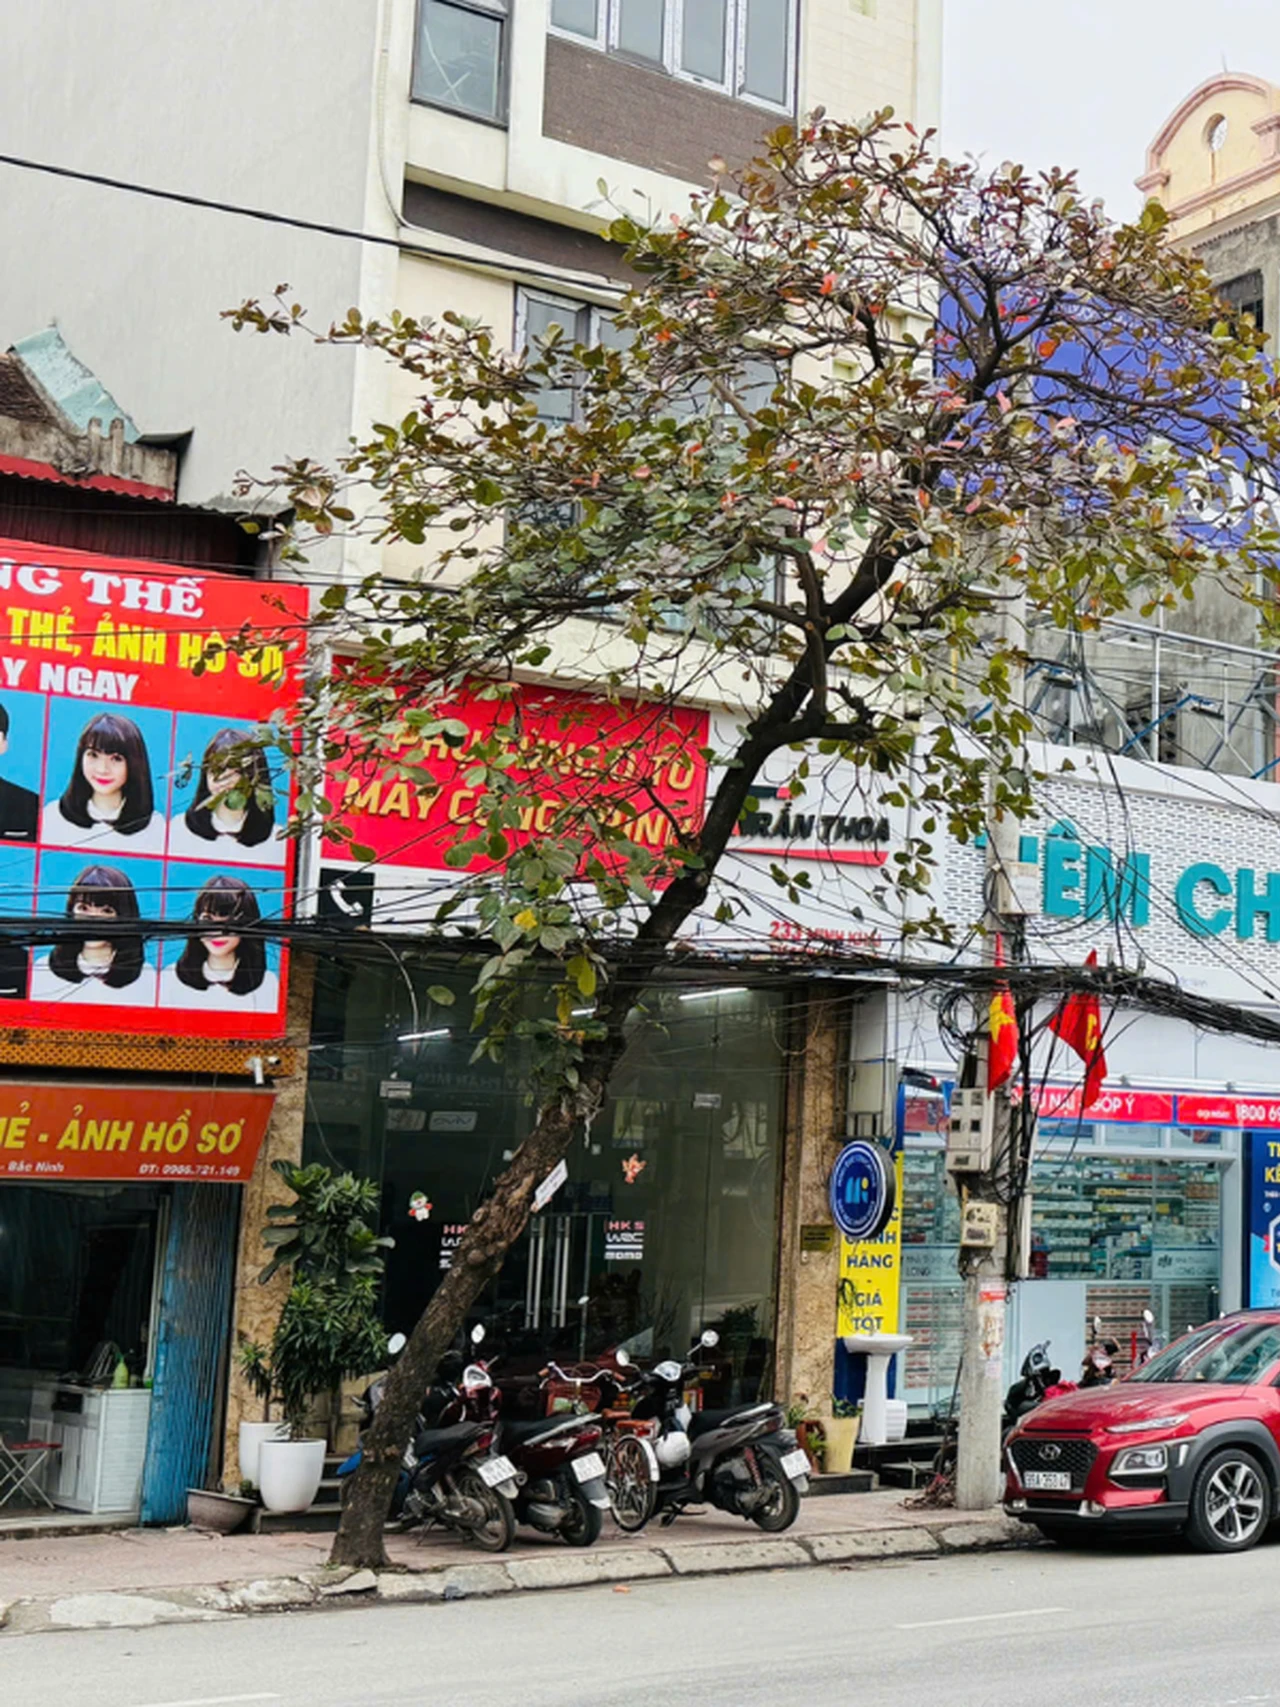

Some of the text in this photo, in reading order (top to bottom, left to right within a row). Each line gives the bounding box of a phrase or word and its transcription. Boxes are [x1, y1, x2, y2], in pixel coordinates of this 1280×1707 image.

[0, 557, 63, 595] G
[6, 605, 82, 658] THẺ,
[91, 612, 167, 665] ẢNH
[0, 656, 139, 701] Y NGAY
[820, 812, 891, 843] THOA
[975, 818, 1151, 929] ÊM
[0, 1100, 31, 1149] Ẻ
[56, 1103, 136, 1152] ẢNH
[139, 1108, 193, 1154] HỒ
[196, 1117, 246, 1155] SƠ
[1236, 1103, 1267, 1121] 1800
